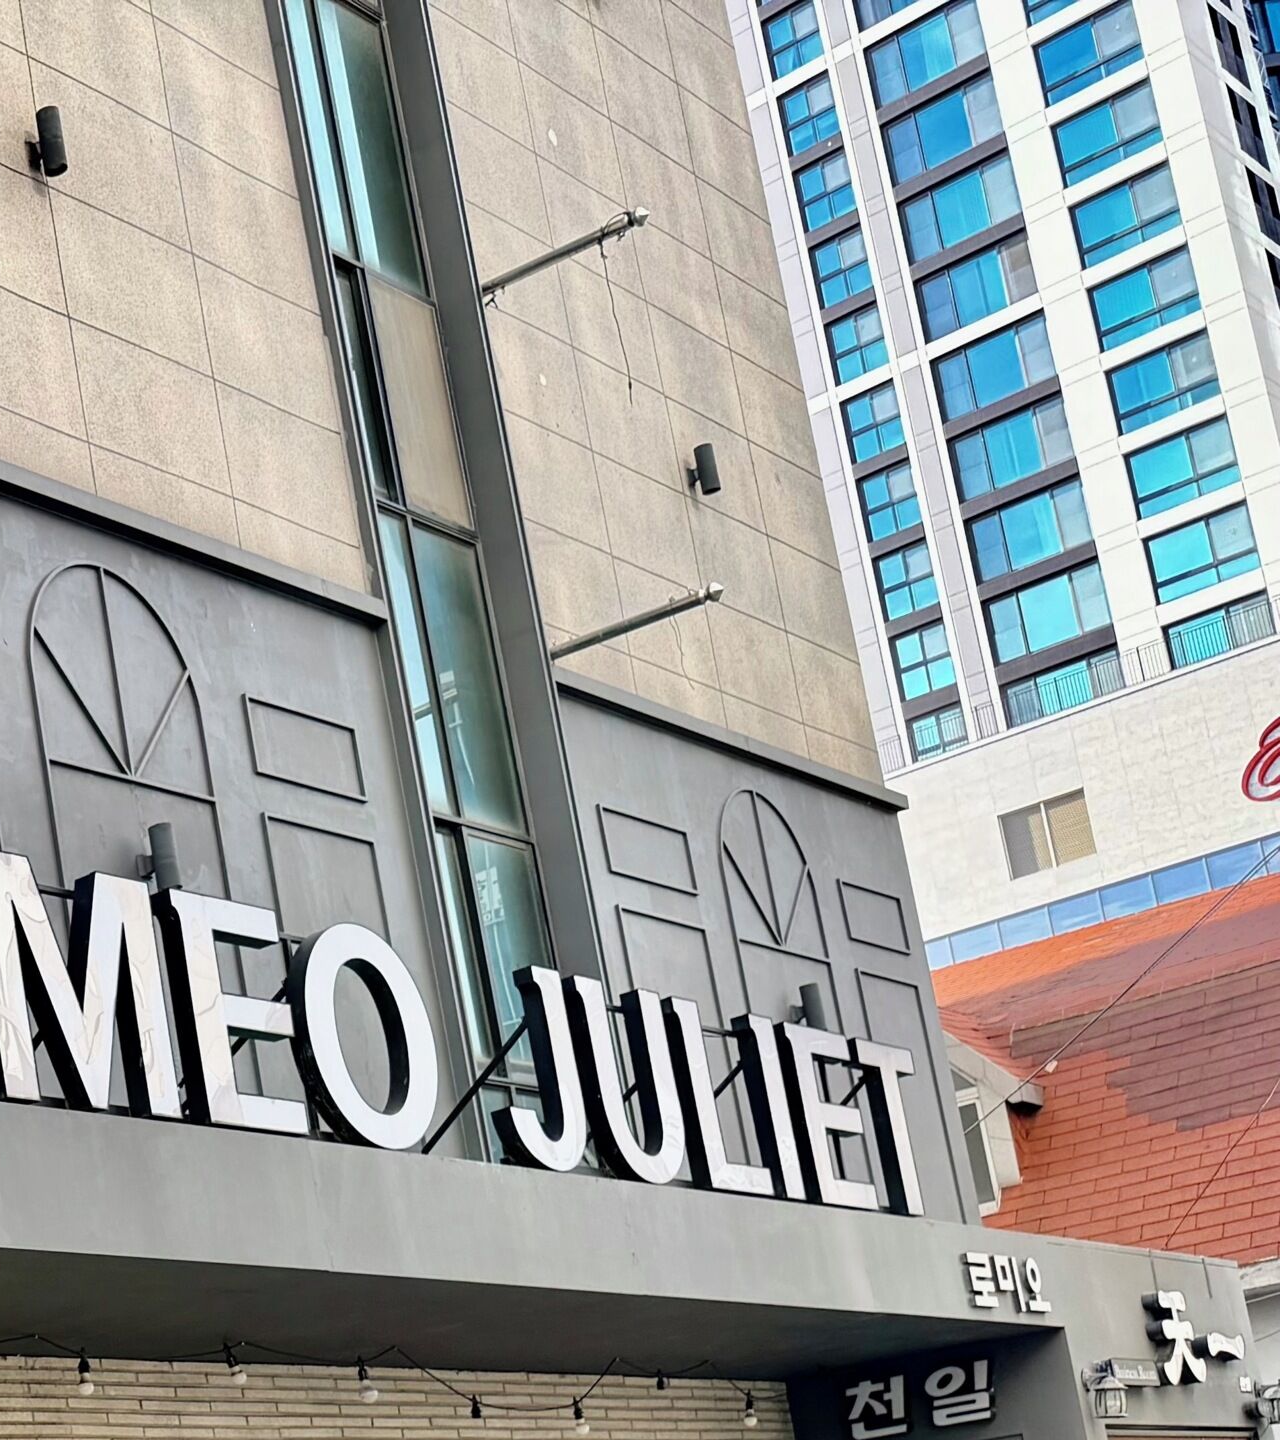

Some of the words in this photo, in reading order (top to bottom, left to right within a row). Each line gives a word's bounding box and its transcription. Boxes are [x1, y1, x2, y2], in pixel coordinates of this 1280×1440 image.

[500, 965, 924, 1216] JULIET
[965, 1251, 1052, 1313] 로미오
[845, 1359, 992, 1440] 천일
